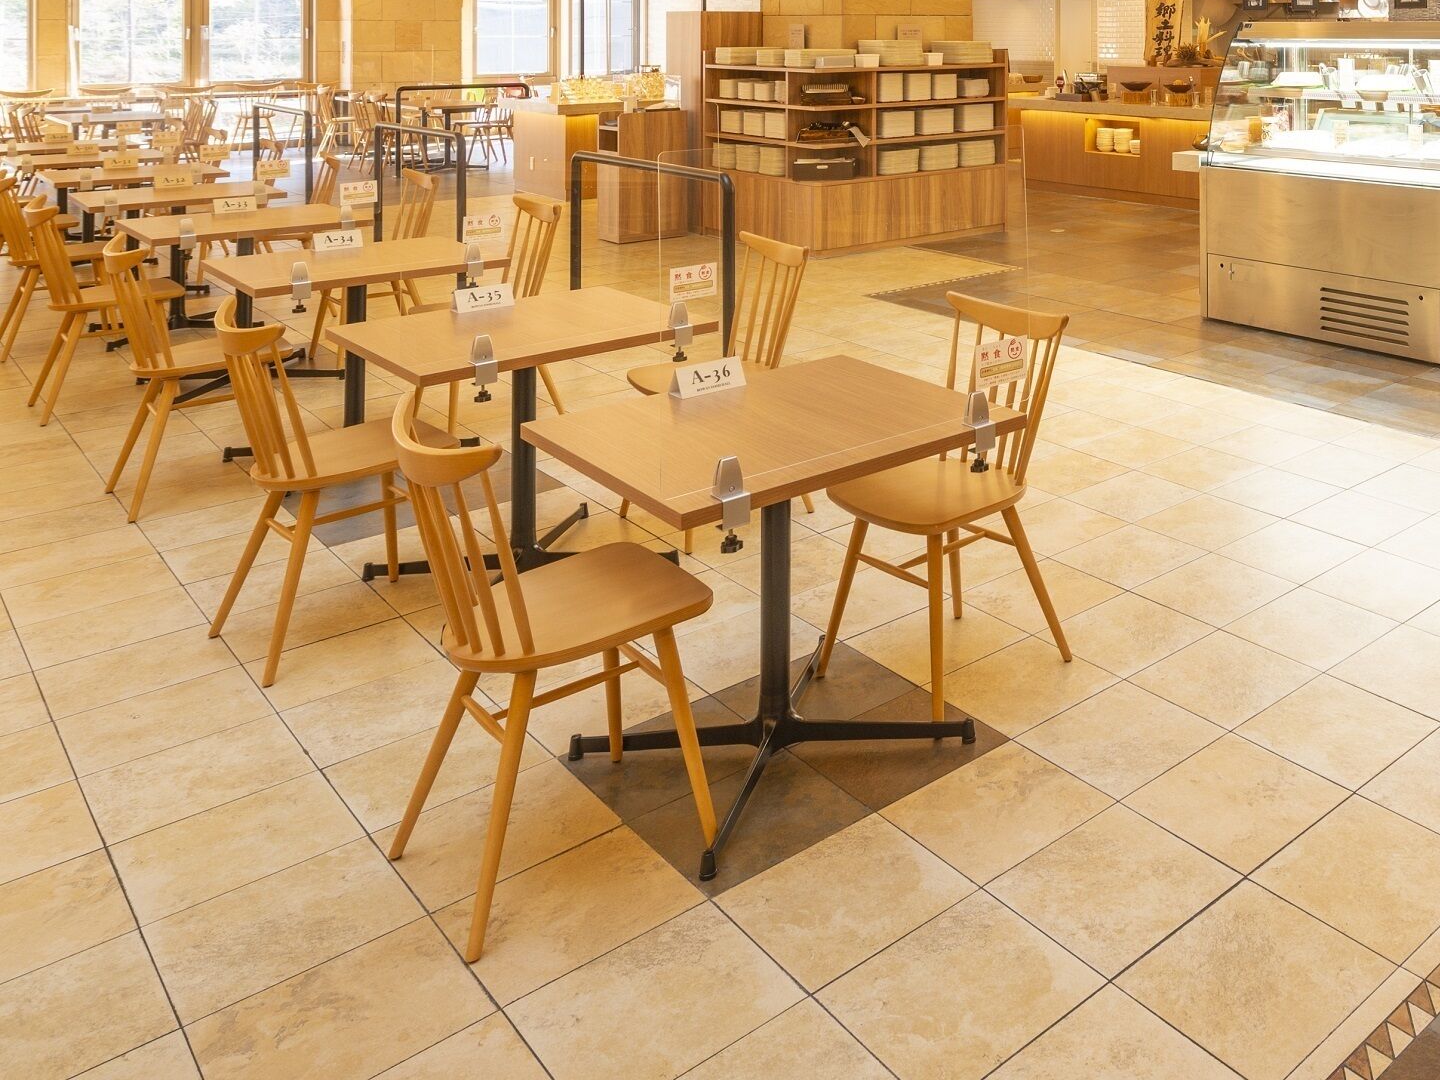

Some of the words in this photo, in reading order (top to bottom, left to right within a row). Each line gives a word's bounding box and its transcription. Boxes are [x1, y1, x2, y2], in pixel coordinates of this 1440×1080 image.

[324, 234, 354, 244] A-34
[468, 290, 502, 302] A-35
[692, 363, 731, 385] A-36
